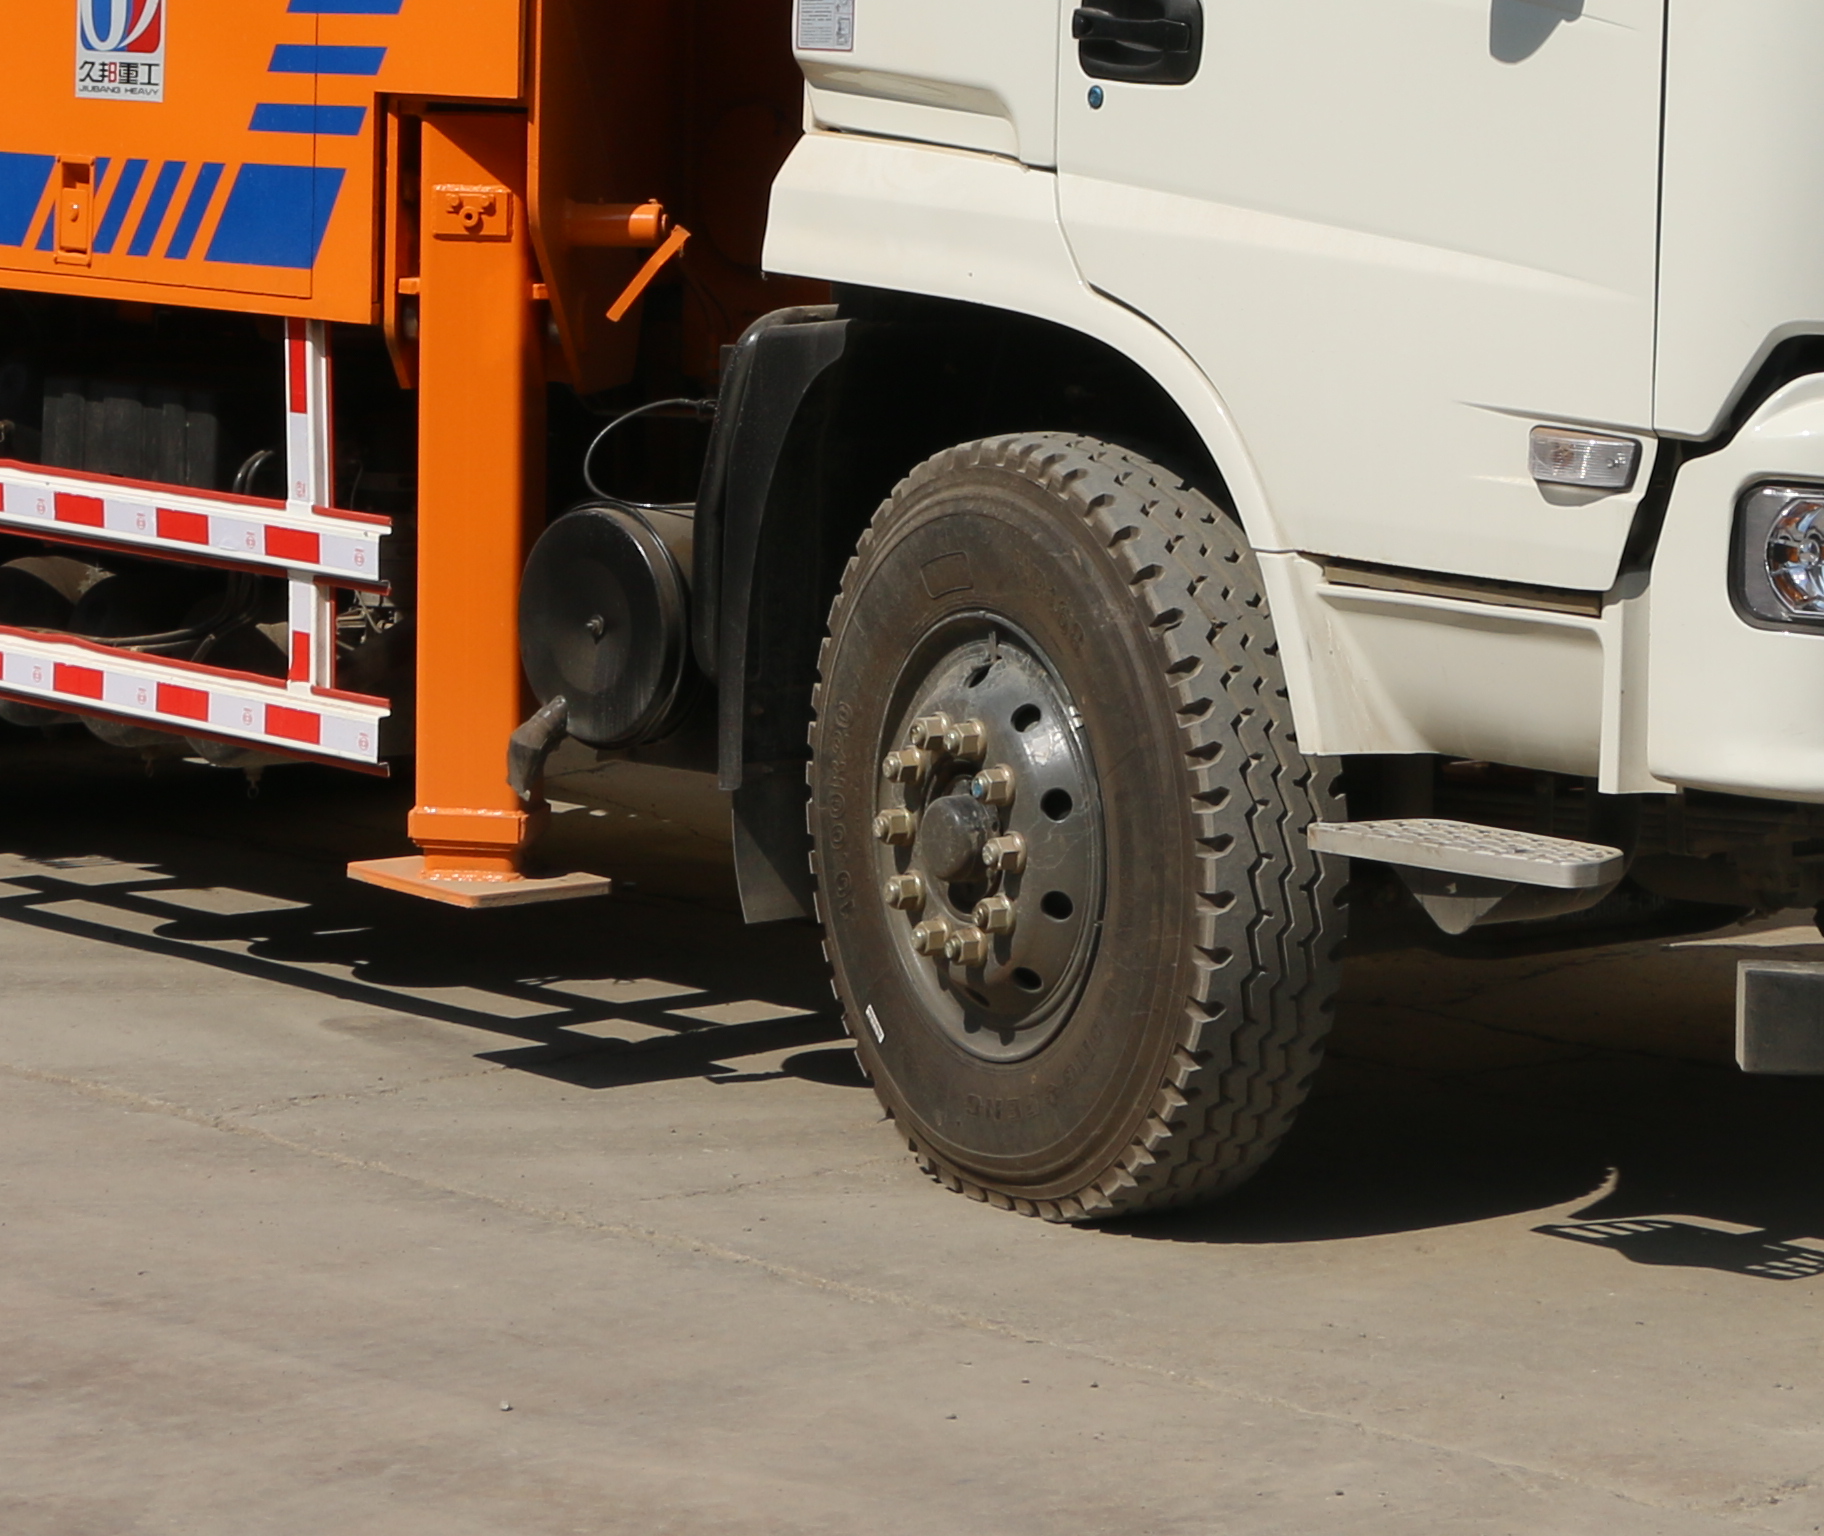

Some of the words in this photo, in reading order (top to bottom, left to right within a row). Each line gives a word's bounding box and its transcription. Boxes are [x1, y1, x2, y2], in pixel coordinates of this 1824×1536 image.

[79, 60, 160, 86] 久邦重工
[79, 85, 121, 94] JIUBANG
[125, 88, 160, 96] HEAVY
